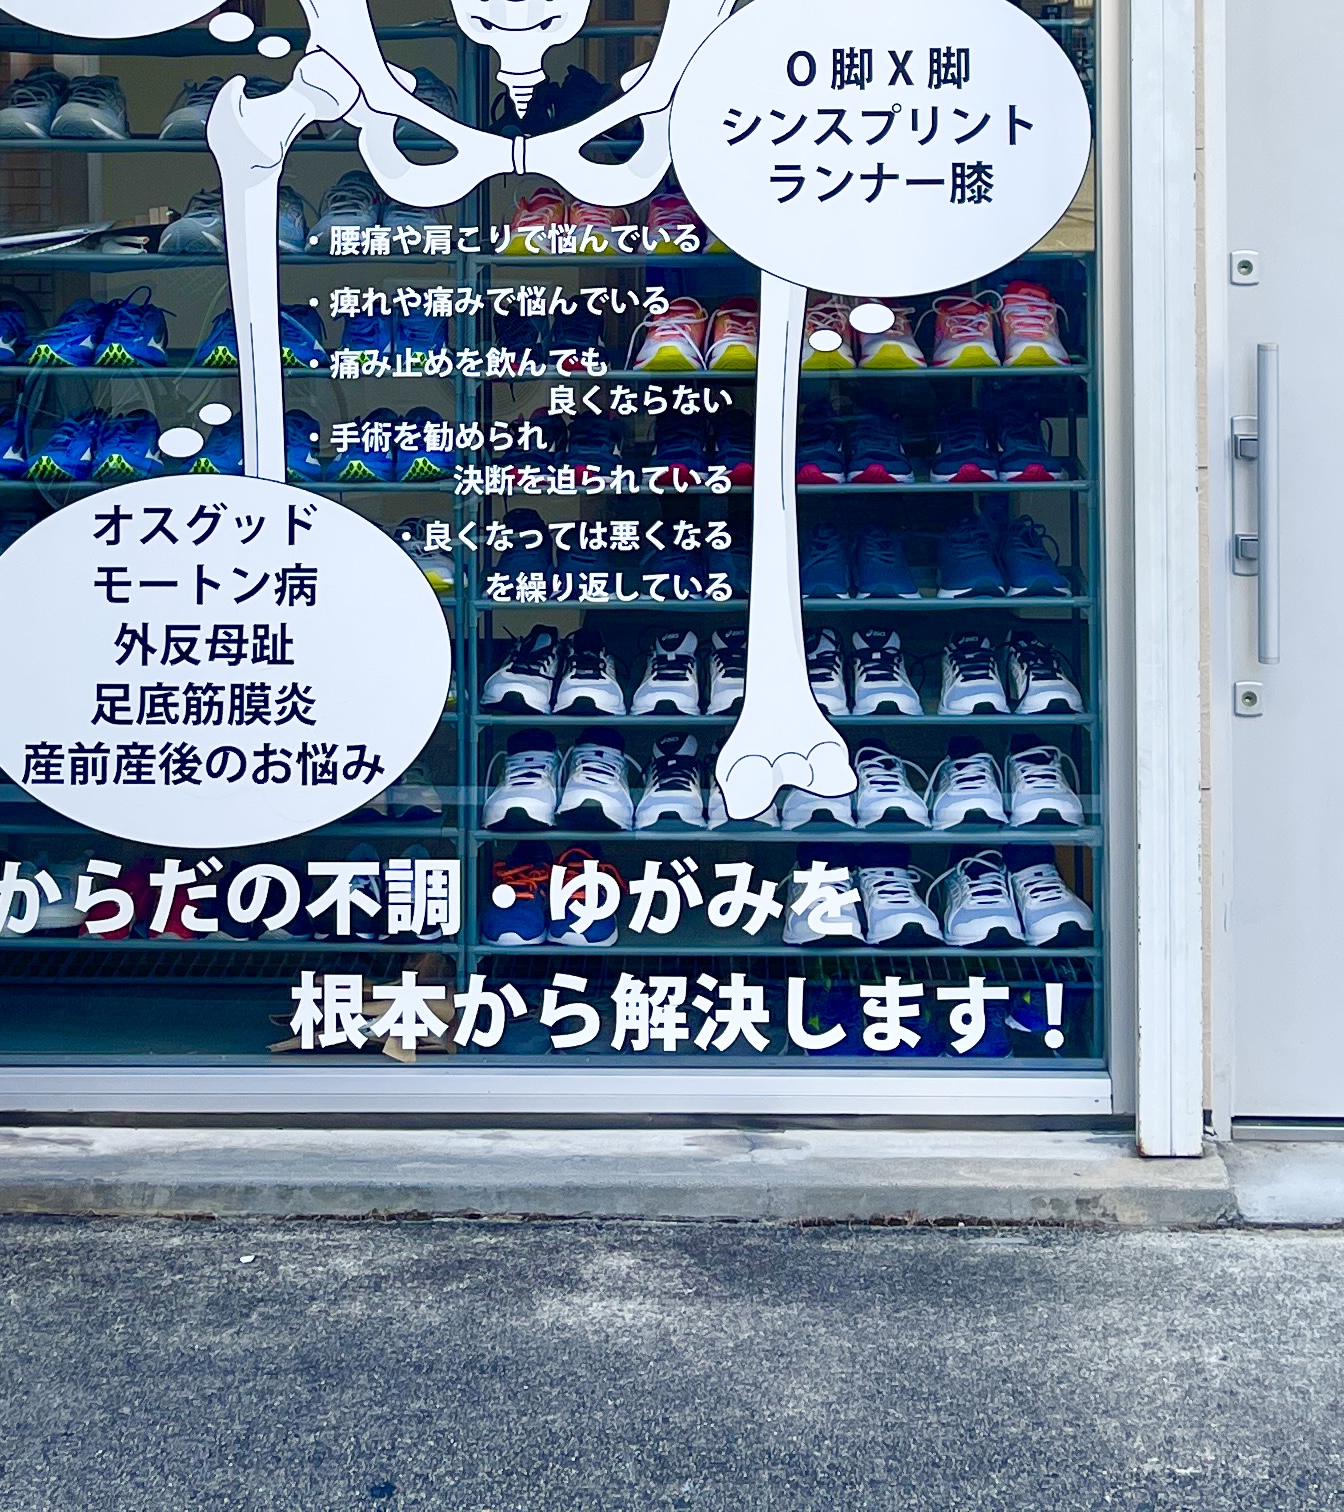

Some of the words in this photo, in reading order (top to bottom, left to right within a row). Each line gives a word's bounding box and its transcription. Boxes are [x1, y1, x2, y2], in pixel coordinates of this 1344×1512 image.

[721, 102, 1035, 147] シンスプリント
[768, 160, 995, 205] ランナー膝
[546, 385, 734, 417] 良くならない
[453, 464, 733, 496] 決断を迫られている
[92, 503, 318, 547] オスグッド
[93, 563, 319, 608] モートン病
[485, 571, 734, 603] を繰り返している
[113, 622, 295, 667] 外反母趾
[90, 682, 318, 727] 足底筋膜炎
[21, 741, 386, 787] 産前産後のお悩み
[289, 969, 1066, 1052] 根本から解決します！
